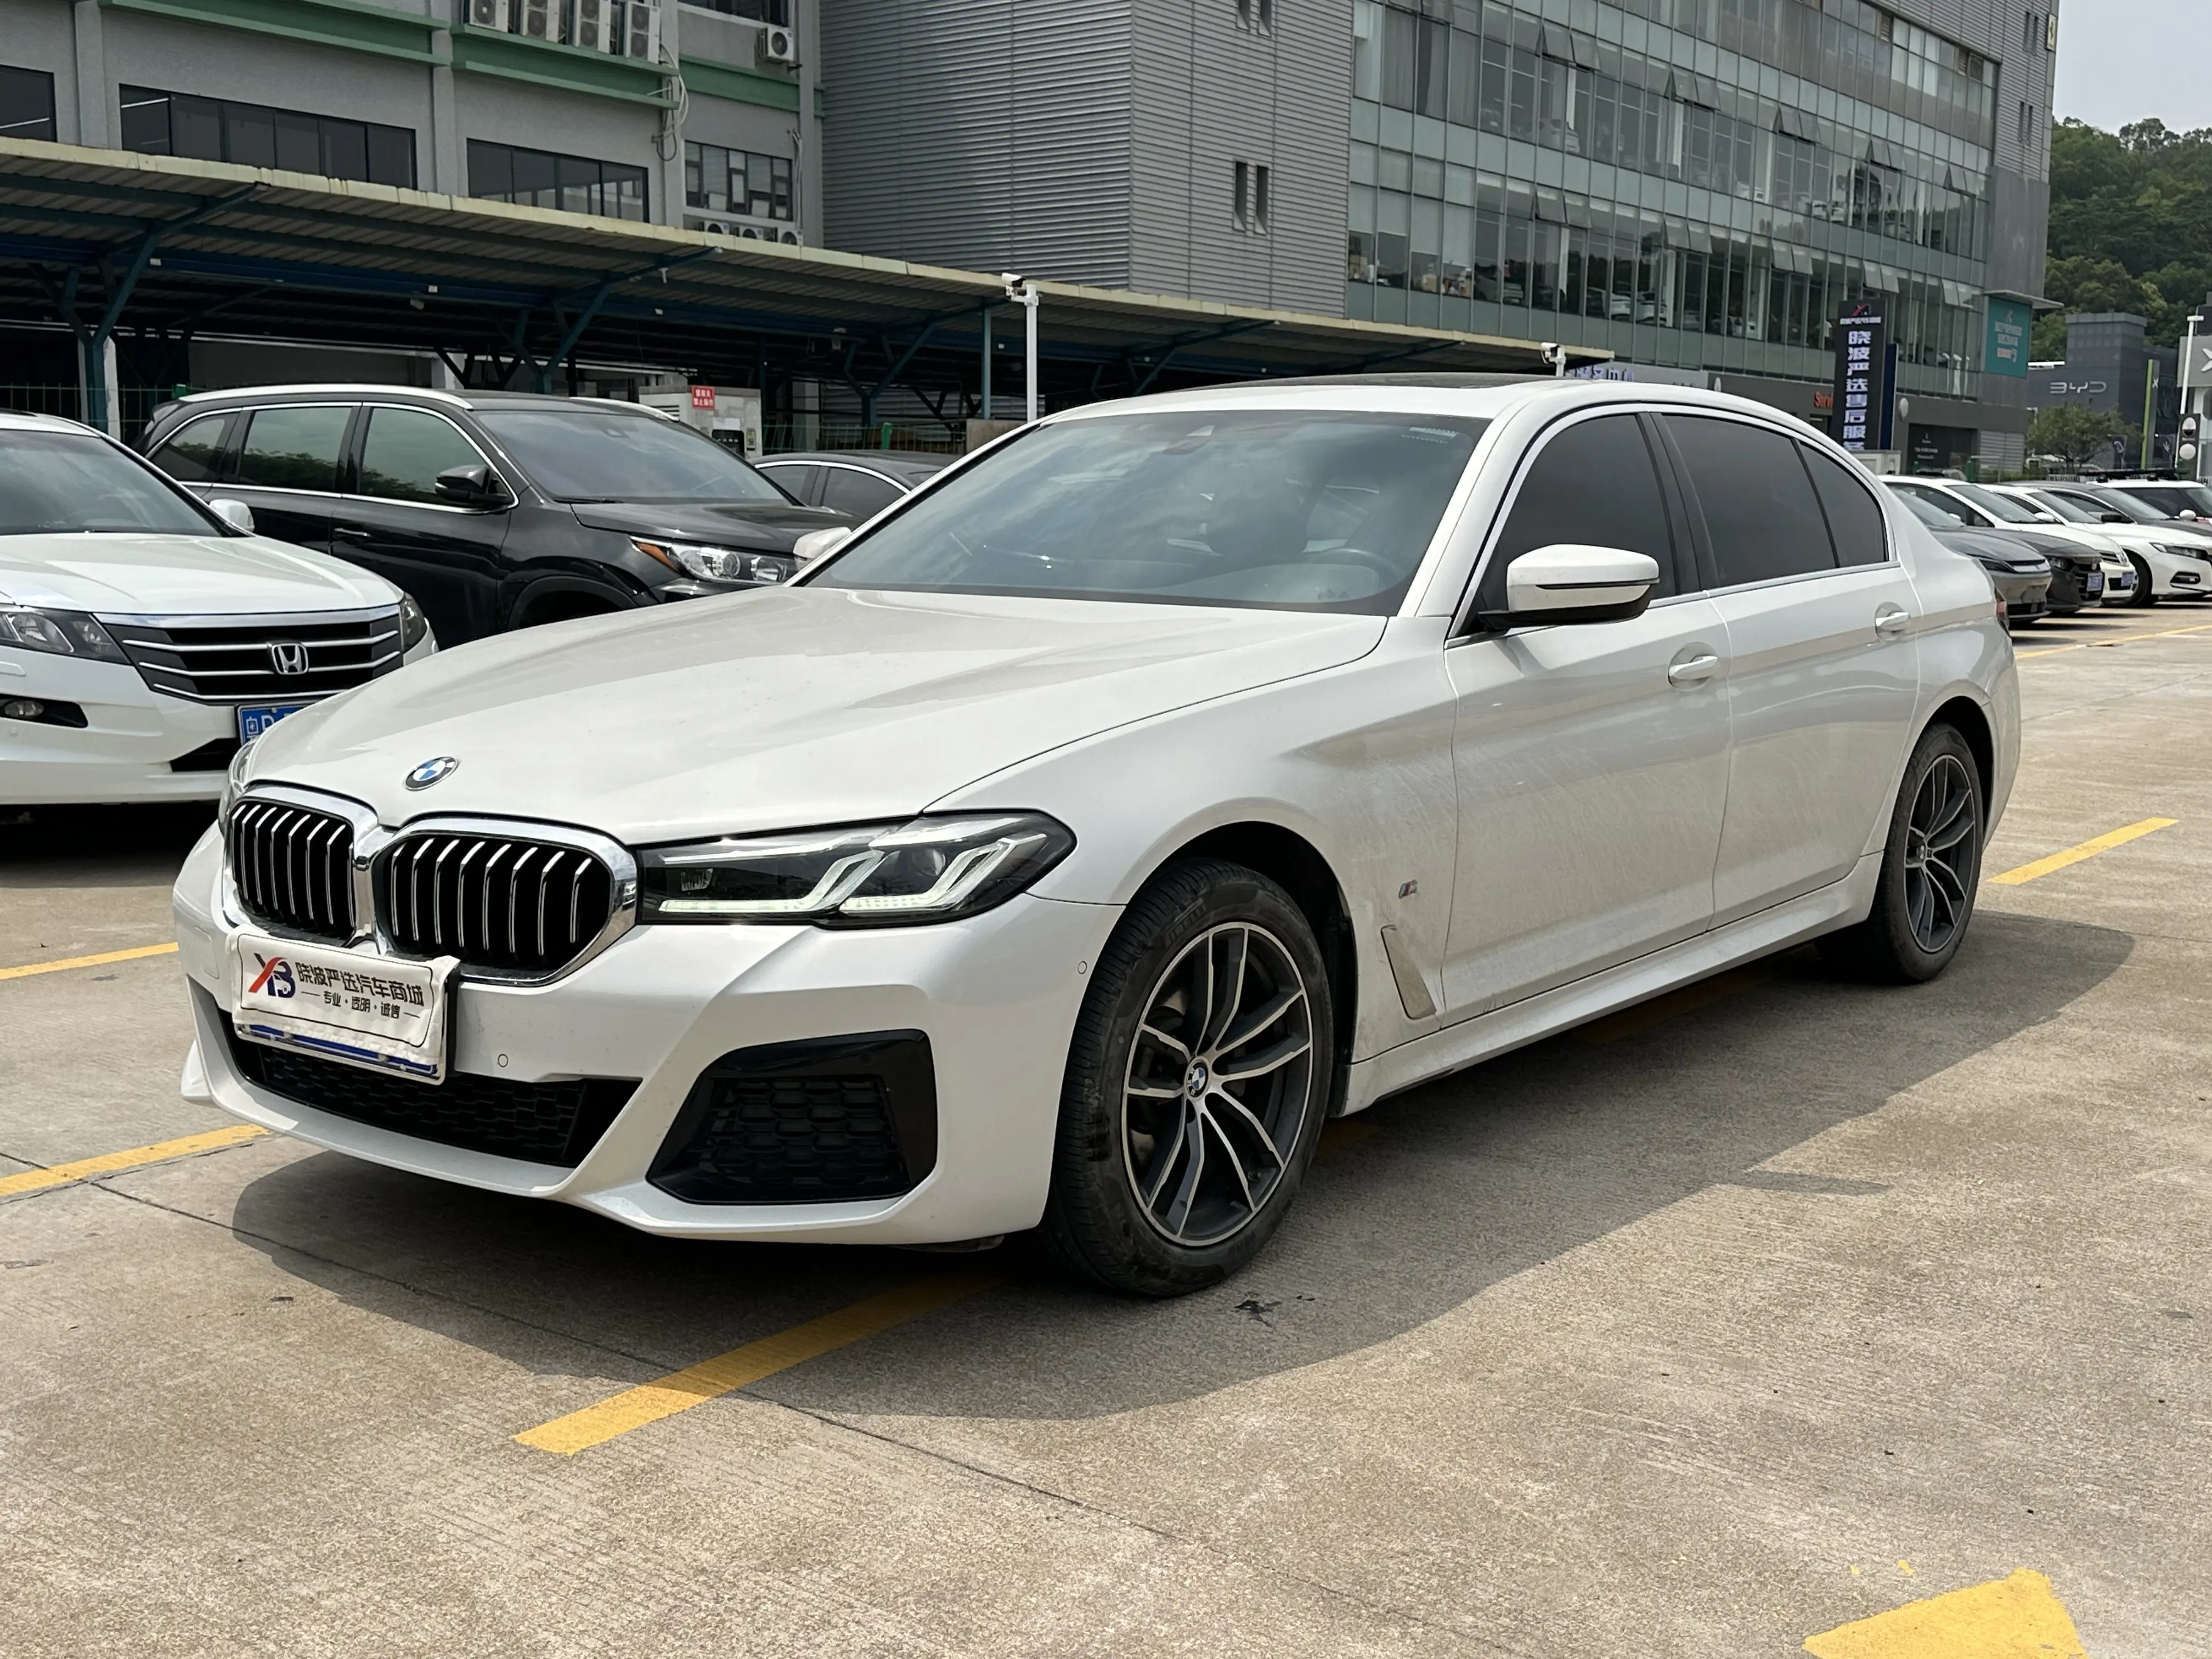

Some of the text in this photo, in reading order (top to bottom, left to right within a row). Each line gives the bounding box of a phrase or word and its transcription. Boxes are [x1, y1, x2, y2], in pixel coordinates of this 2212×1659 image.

[2050, 381, 2107, 394] BYD
[295, 961, 425, 1007] 晓波严选汽车商城
